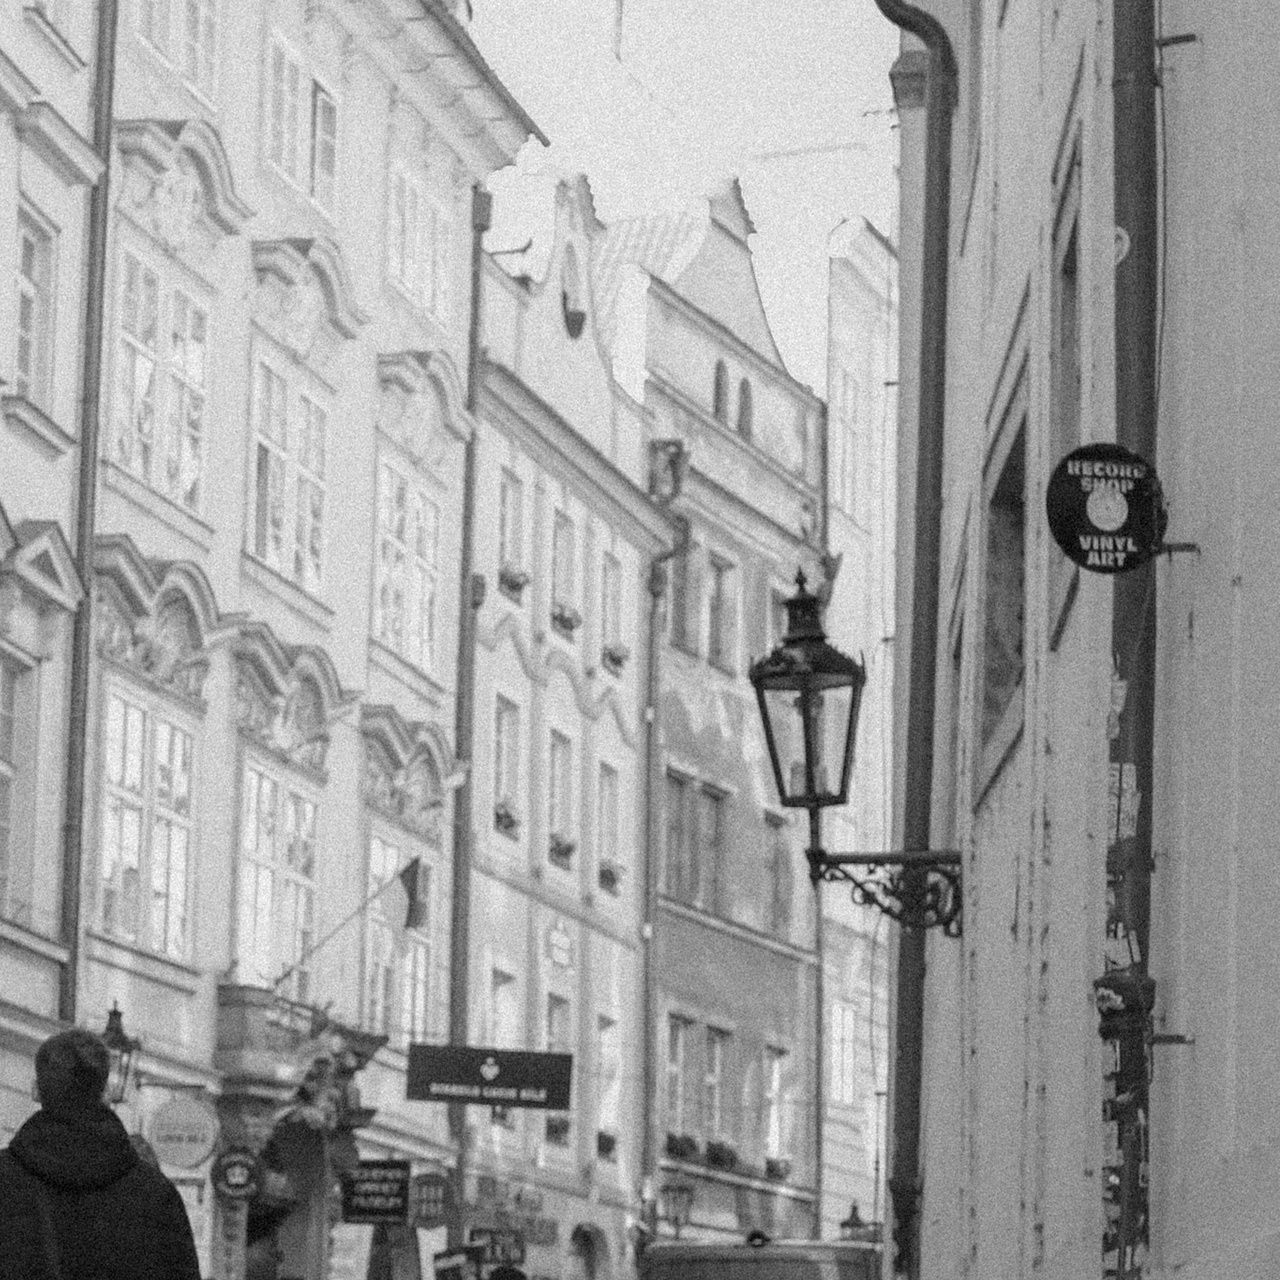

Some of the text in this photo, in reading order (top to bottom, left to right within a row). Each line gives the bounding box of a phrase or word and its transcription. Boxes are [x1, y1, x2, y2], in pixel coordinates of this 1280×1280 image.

[1067, 461, 1146, 478] RECORD
[1081, 478, 1135, 493] SHOP
[1079, 536, 1138, 552] VINYL
[1087, 552, 1126, 567] ART
